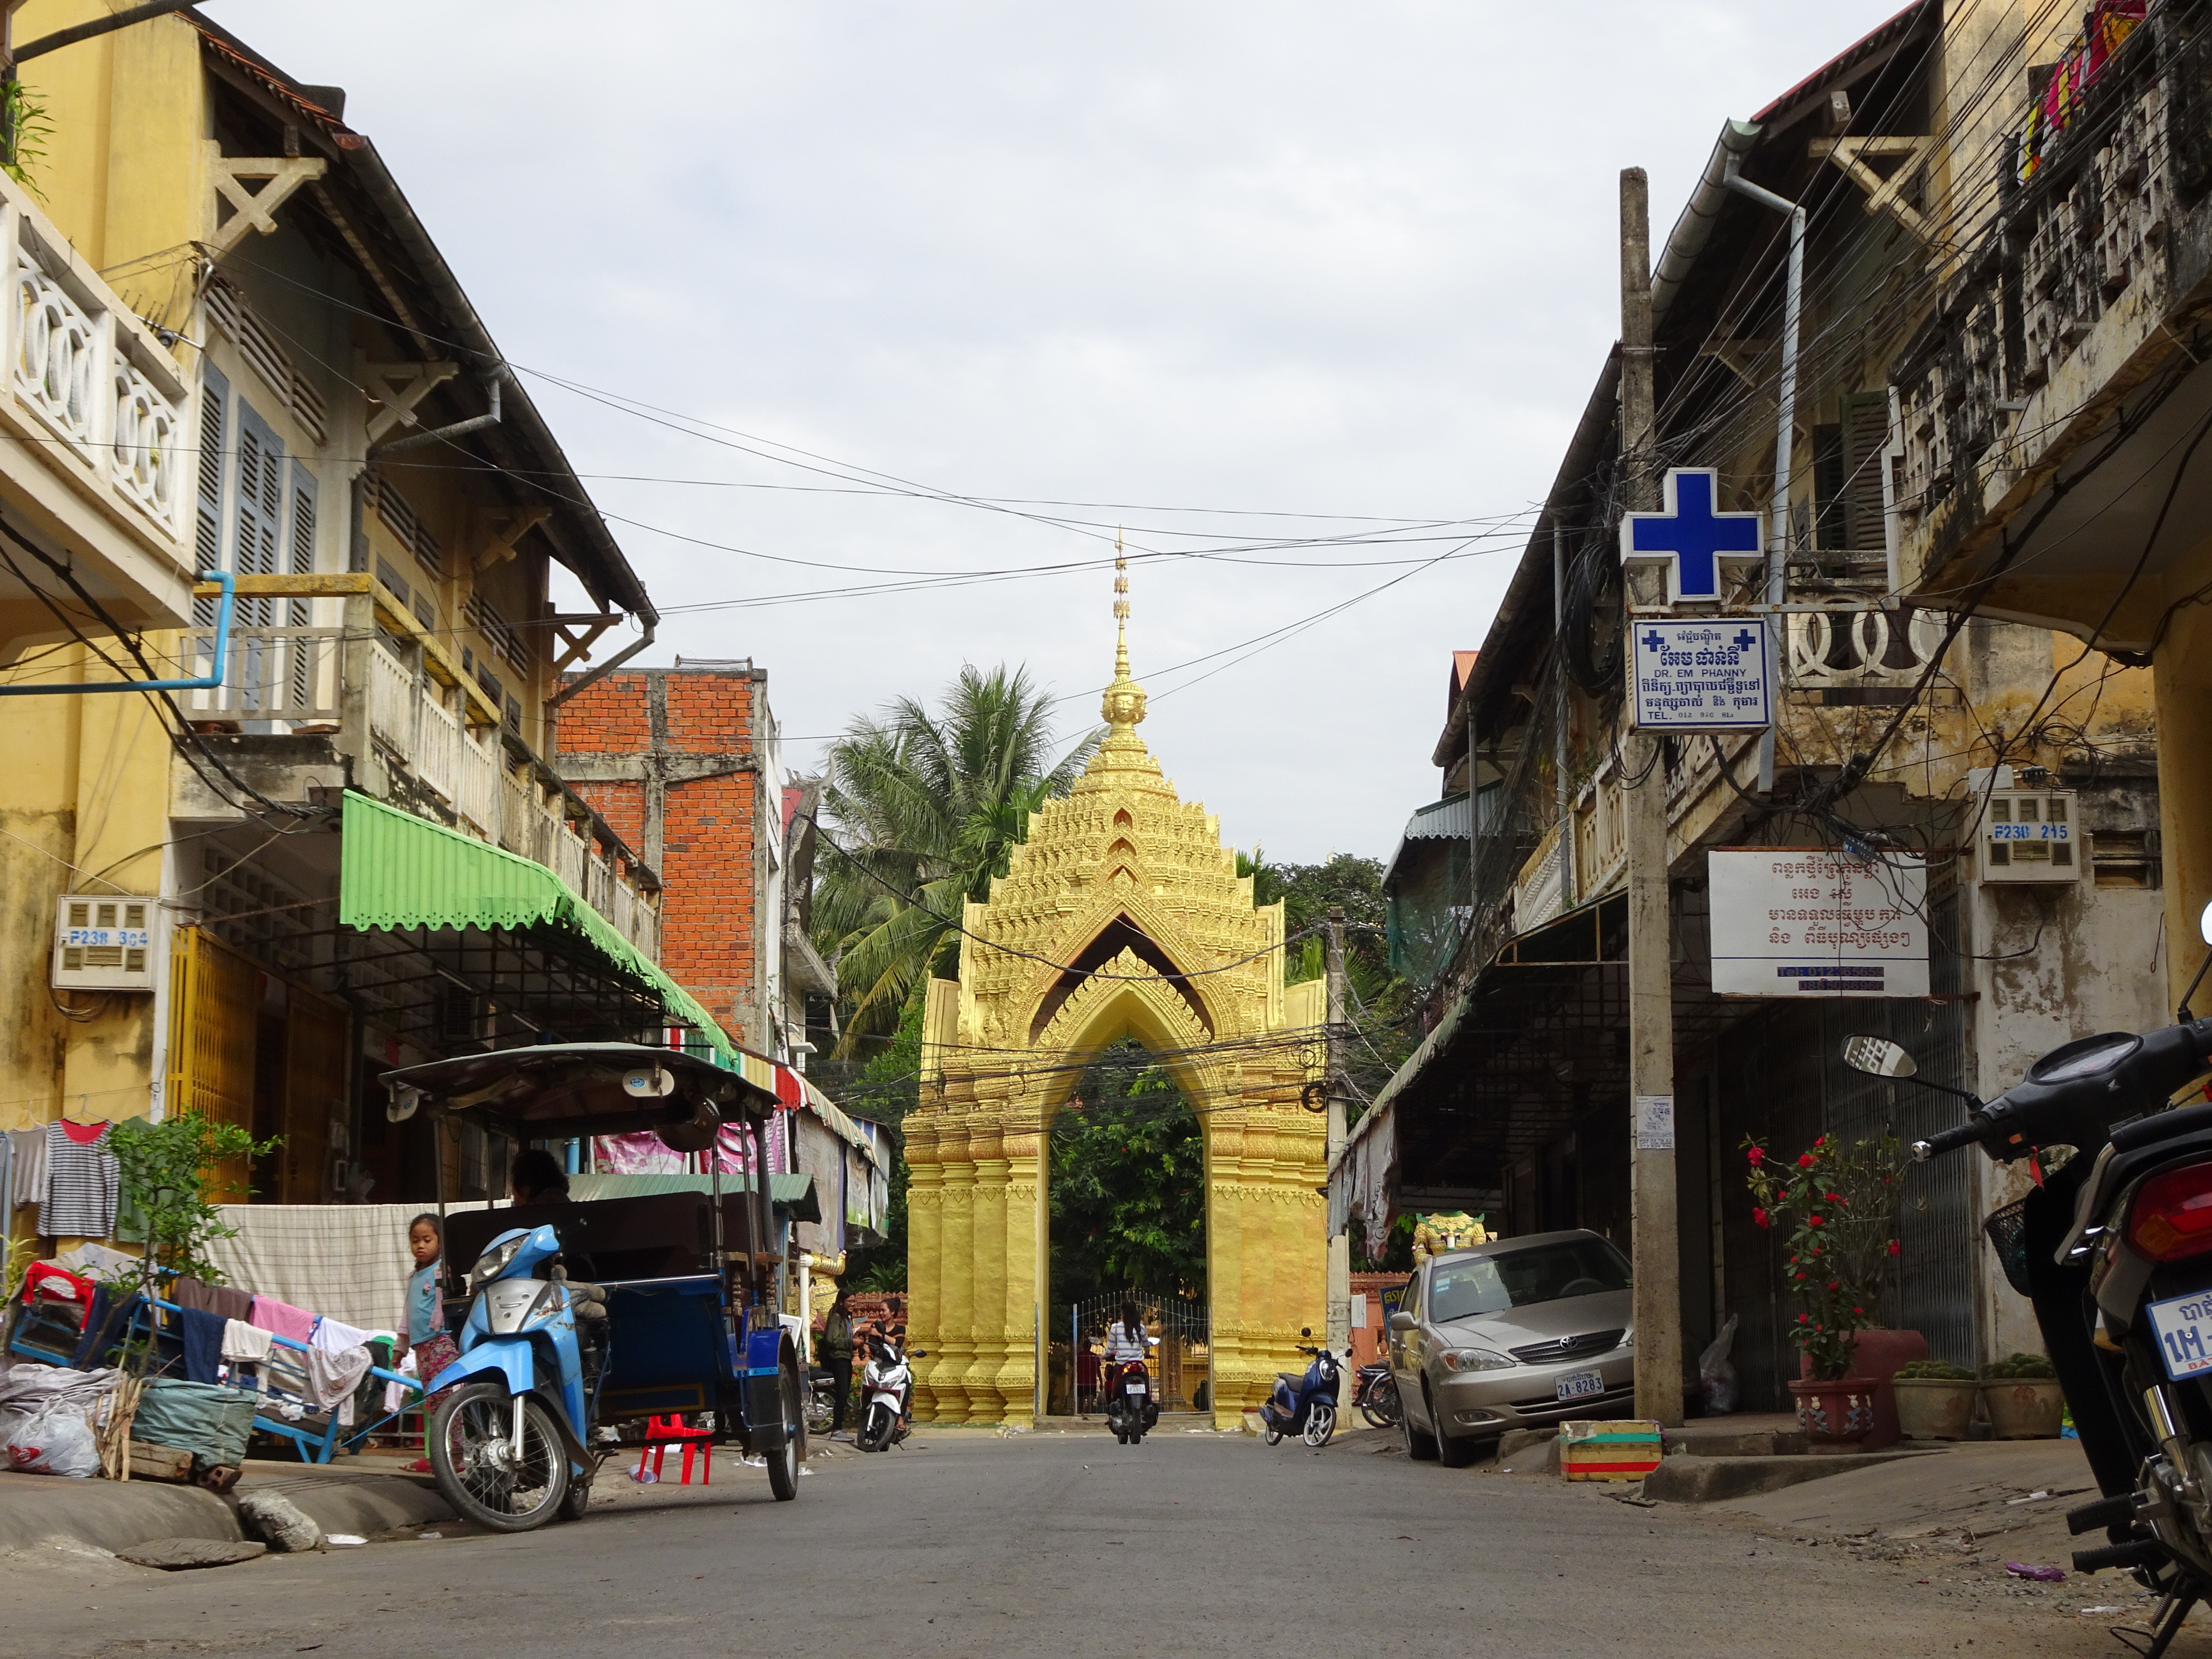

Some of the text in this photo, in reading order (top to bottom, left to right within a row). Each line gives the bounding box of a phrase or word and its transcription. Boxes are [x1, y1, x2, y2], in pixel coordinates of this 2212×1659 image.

[1654, 669, 1747, 678] DR. EM PHANNY
[1648, 711, 1672, 720] TEL.
[2041, 825, 2067, 839] 215
[1557, 1378, 1602, 1397] 2A-8283
